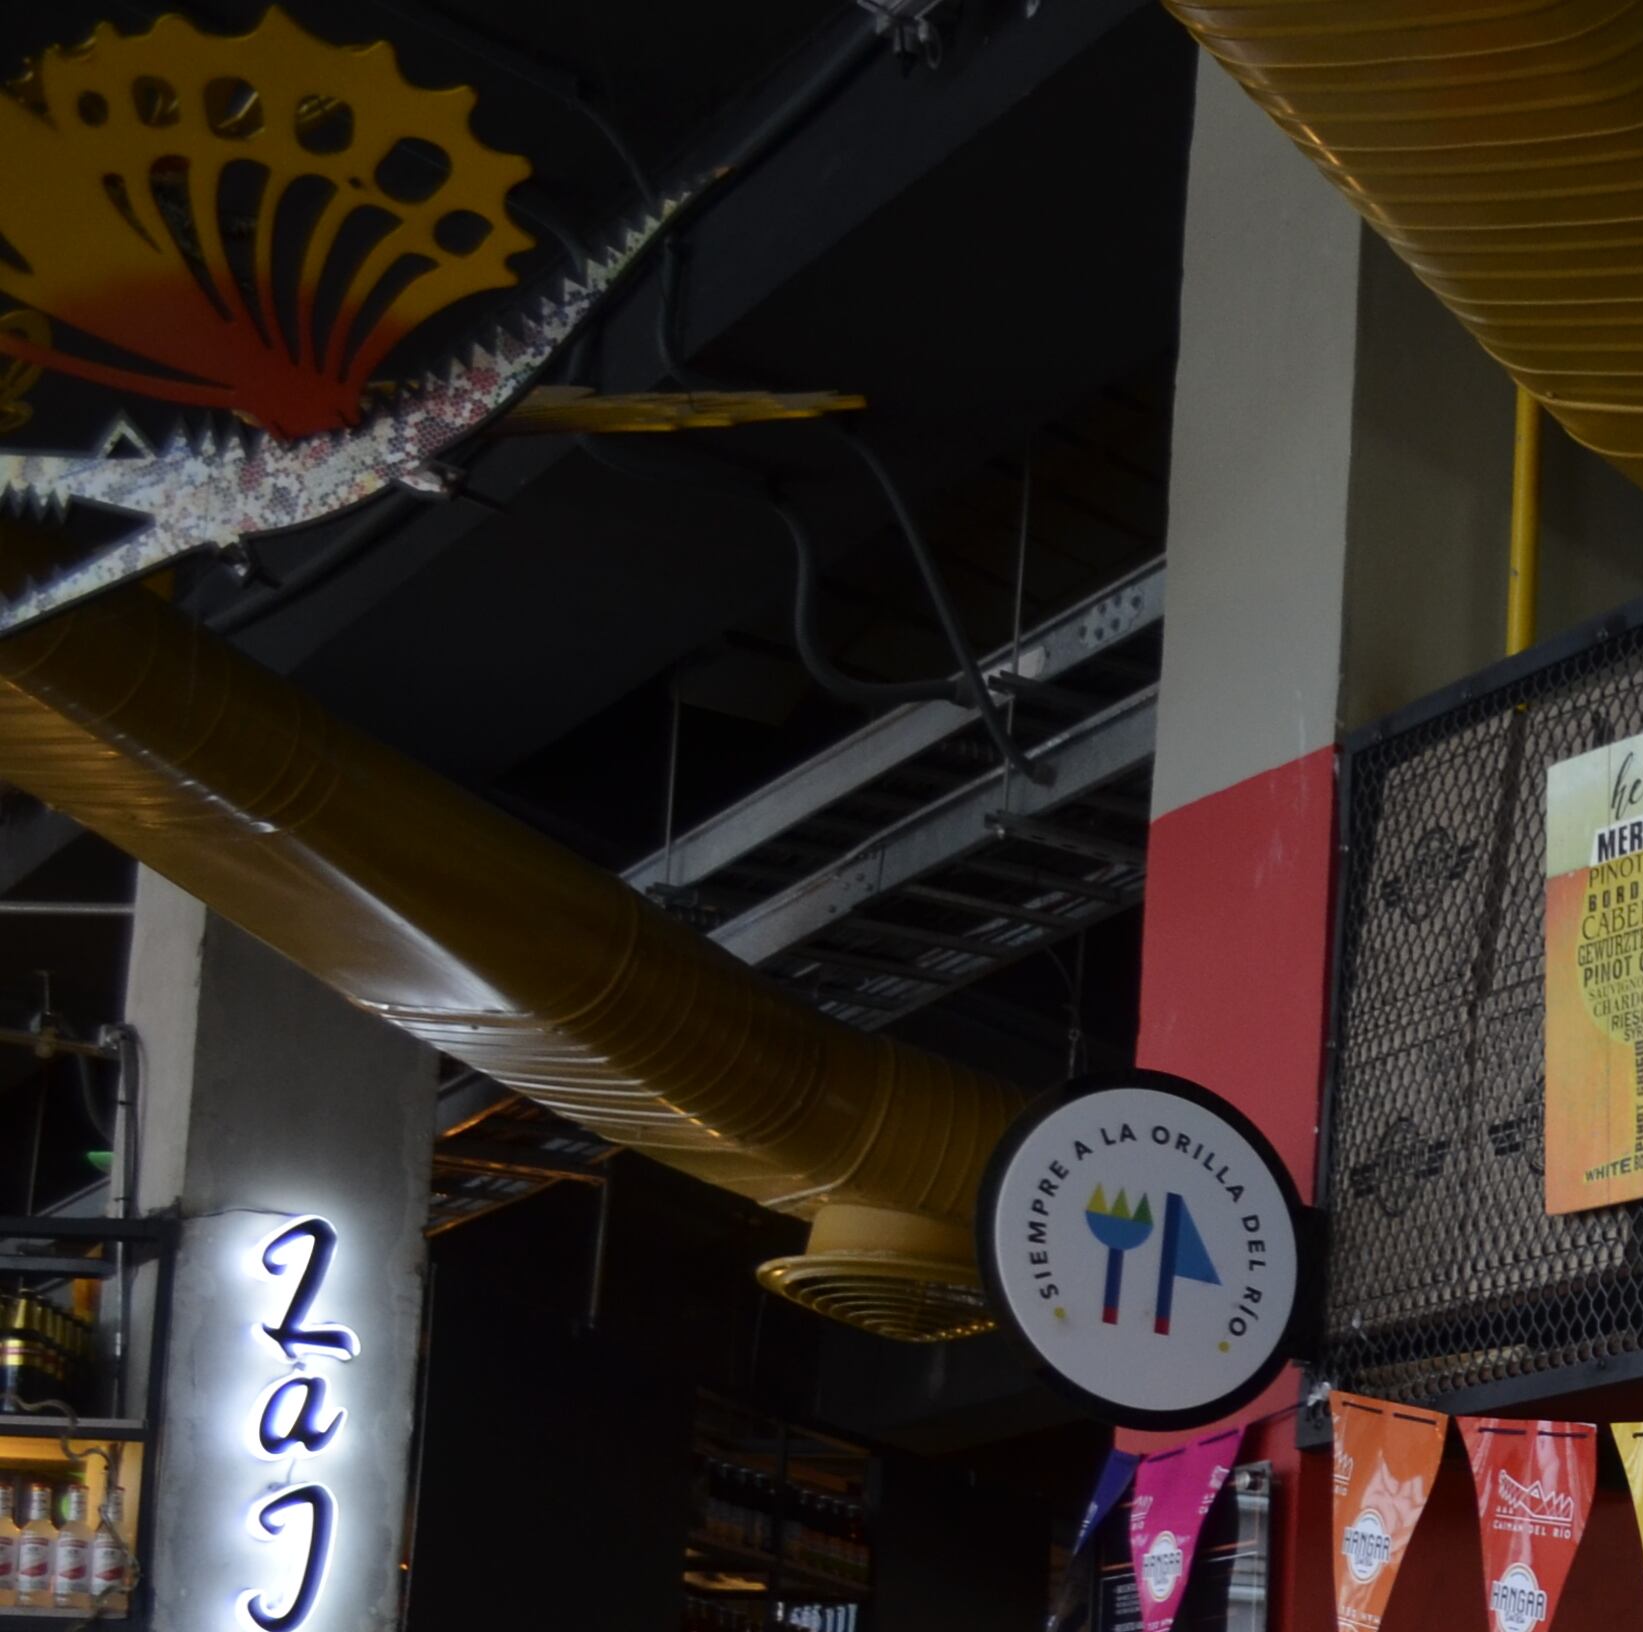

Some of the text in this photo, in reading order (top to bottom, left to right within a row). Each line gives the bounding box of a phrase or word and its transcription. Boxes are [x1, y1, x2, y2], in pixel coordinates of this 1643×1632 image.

[1583, 954, 1634, 988] PINOT
[1027, 1122, 1266, 1337] SIEMPRE A LA ORILLA DEL RÍO
[1585, 1155, 1632, 1182] WHITE
[254, 1213, 362, 1459] La
